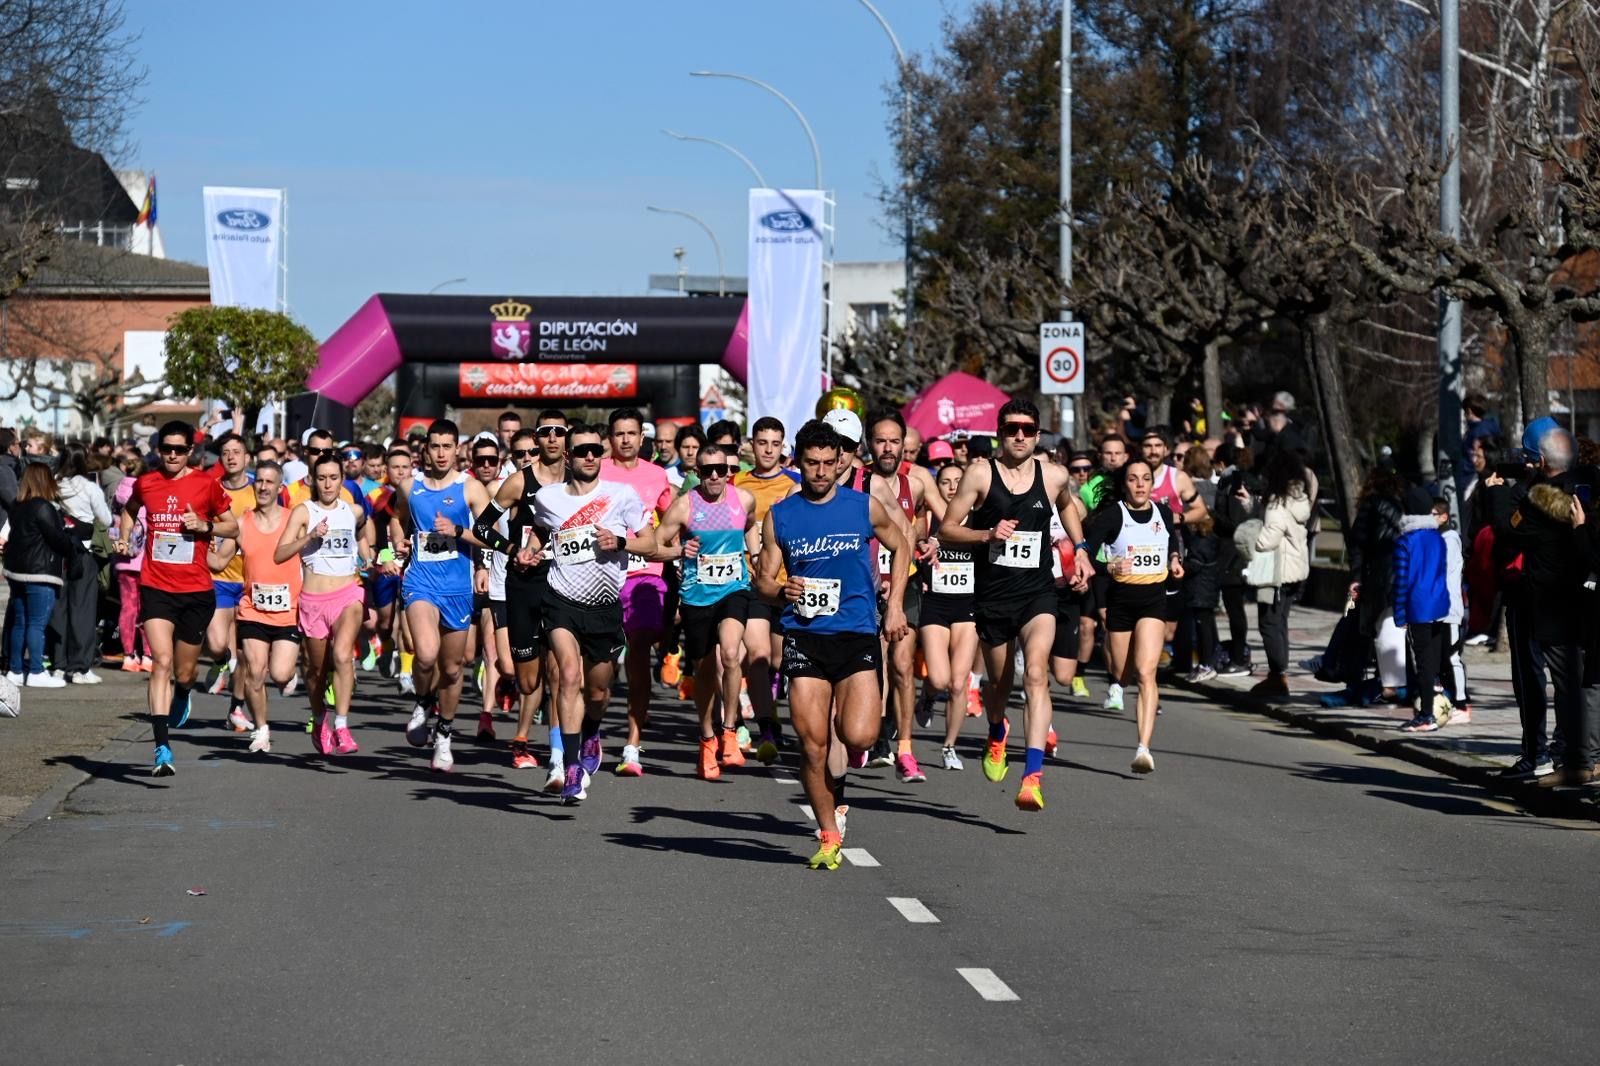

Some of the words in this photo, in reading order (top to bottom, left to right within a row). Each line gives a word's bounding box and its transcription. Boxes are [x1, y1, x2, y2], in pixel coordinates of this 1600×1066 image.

[540, 319, 637, 336] DIPUTACIÓN
[1043, 327, 1081, 338] ZONA
[540, 339, 559, 351] DE
[564, 336, 606, 351] LEÓN
[1053, 359, 1072, 371] 30
[486, 381, 537, 395] cuatro
[152, 513, 185, 522] SERRAN
[167, 544, 177, 555] 7
[324, 538, 349, 549] 132
[561, 537, 593, 556] 394
[790, 537, 860, 557] intelligent
[1133, 554, 1161, 567] 399
[705, 564, 734, 577] 173
[940, 574, 968, 586] 105
[257, 593, 283, 605] 313
